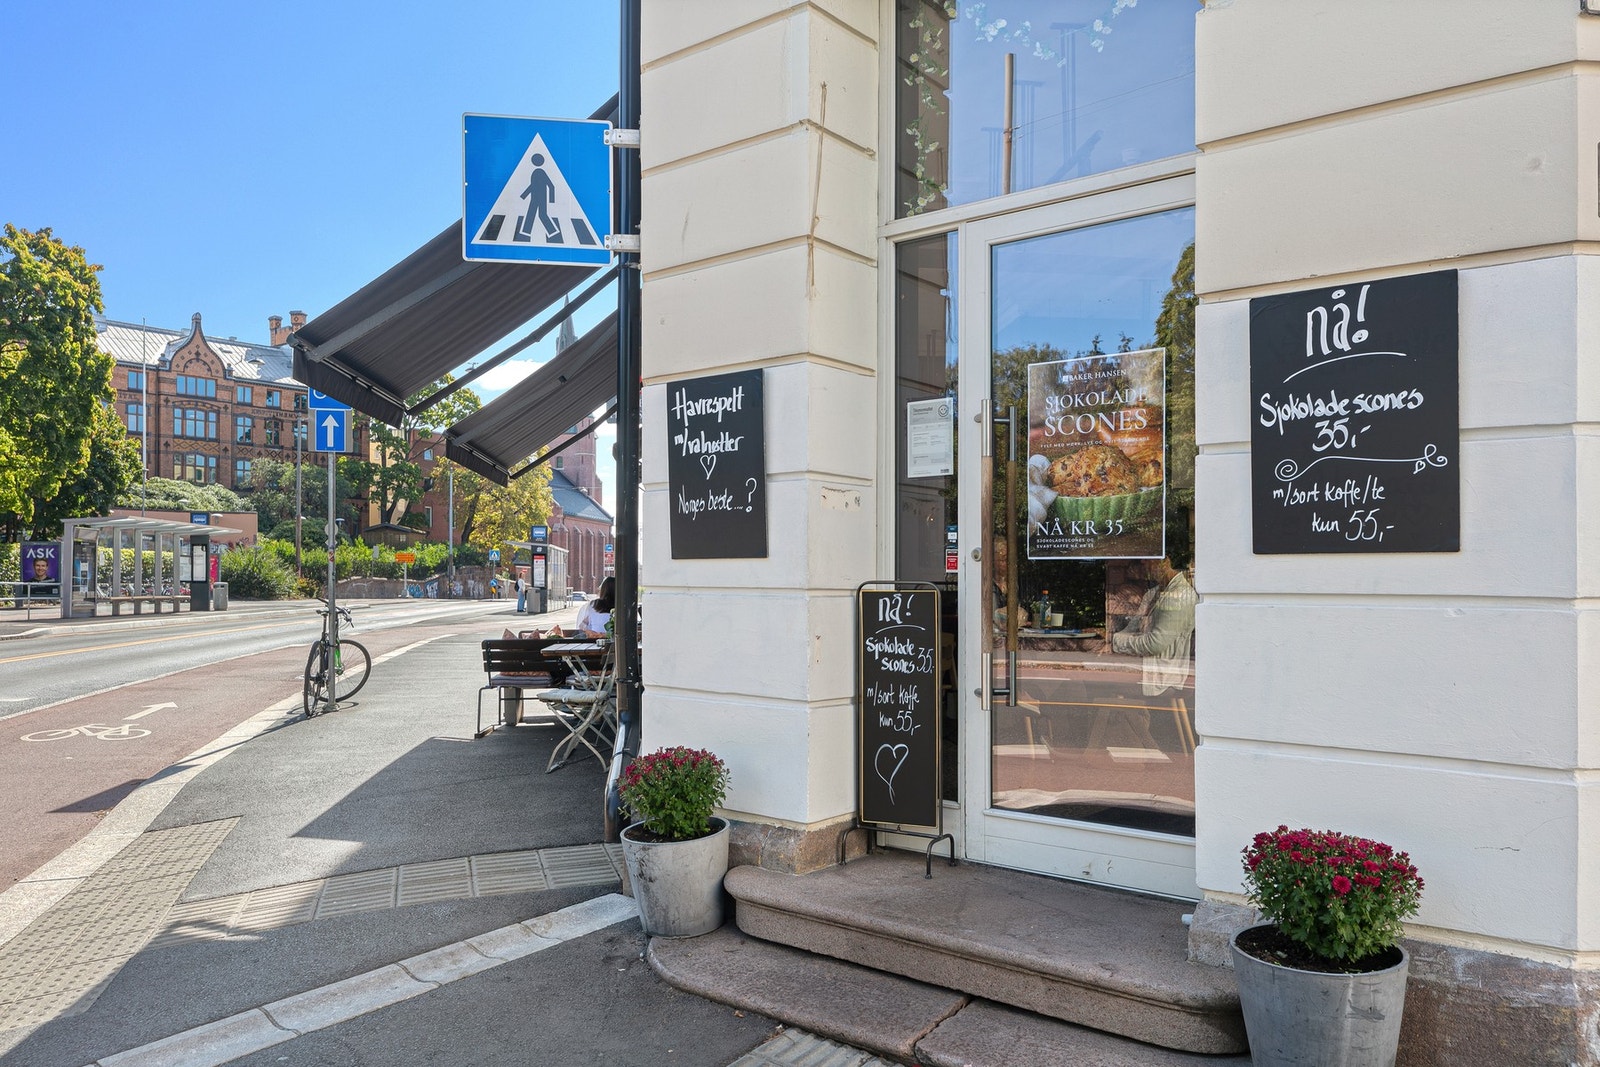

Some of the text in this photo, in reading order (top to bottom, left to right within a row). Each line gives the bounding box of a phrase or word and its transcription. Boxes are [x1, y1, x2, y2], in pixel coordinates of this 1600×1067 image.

[1306, 284, 1371, 357] nå!
[1069, 369, 1127, 381] BAKER HANSEN
[671, 386, 745, 427] Havrespelt
[1045, 387, 1149, 414] SJOKOLADE
[1044, 408, 1148, 437] SCONES
[678, 484, 706, 521] Norges
[1035, 517, 1124, 536] NÅ KR 35
[26, 548, 56, 559] ASK
